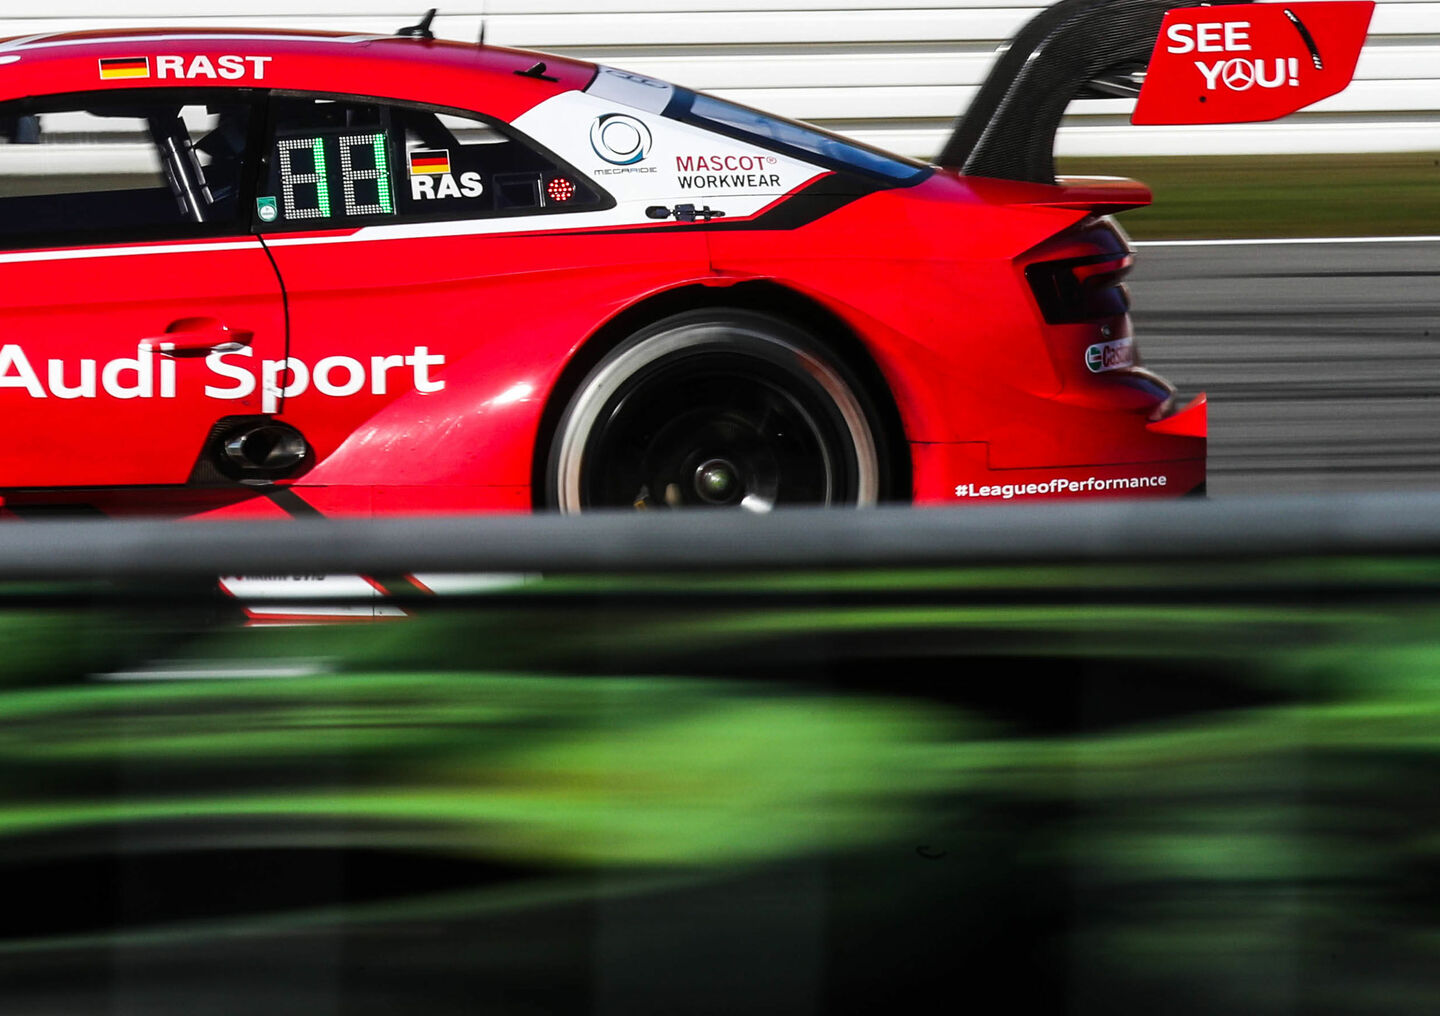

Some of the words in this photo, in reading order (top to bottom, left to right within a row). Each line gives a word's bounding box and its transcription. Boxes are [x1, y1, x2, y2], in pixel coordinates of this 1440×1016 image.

[1166, 21, 1251, 54] SEE
[156, 55, 272, 80] RAST
[410, 171, 484, 201] RAS
[677, 174, 781, 189] WORKWEAR
[204, 345, 446, 414] Sport
[955, 473, 1167, 499] #LeagueofPerformance
